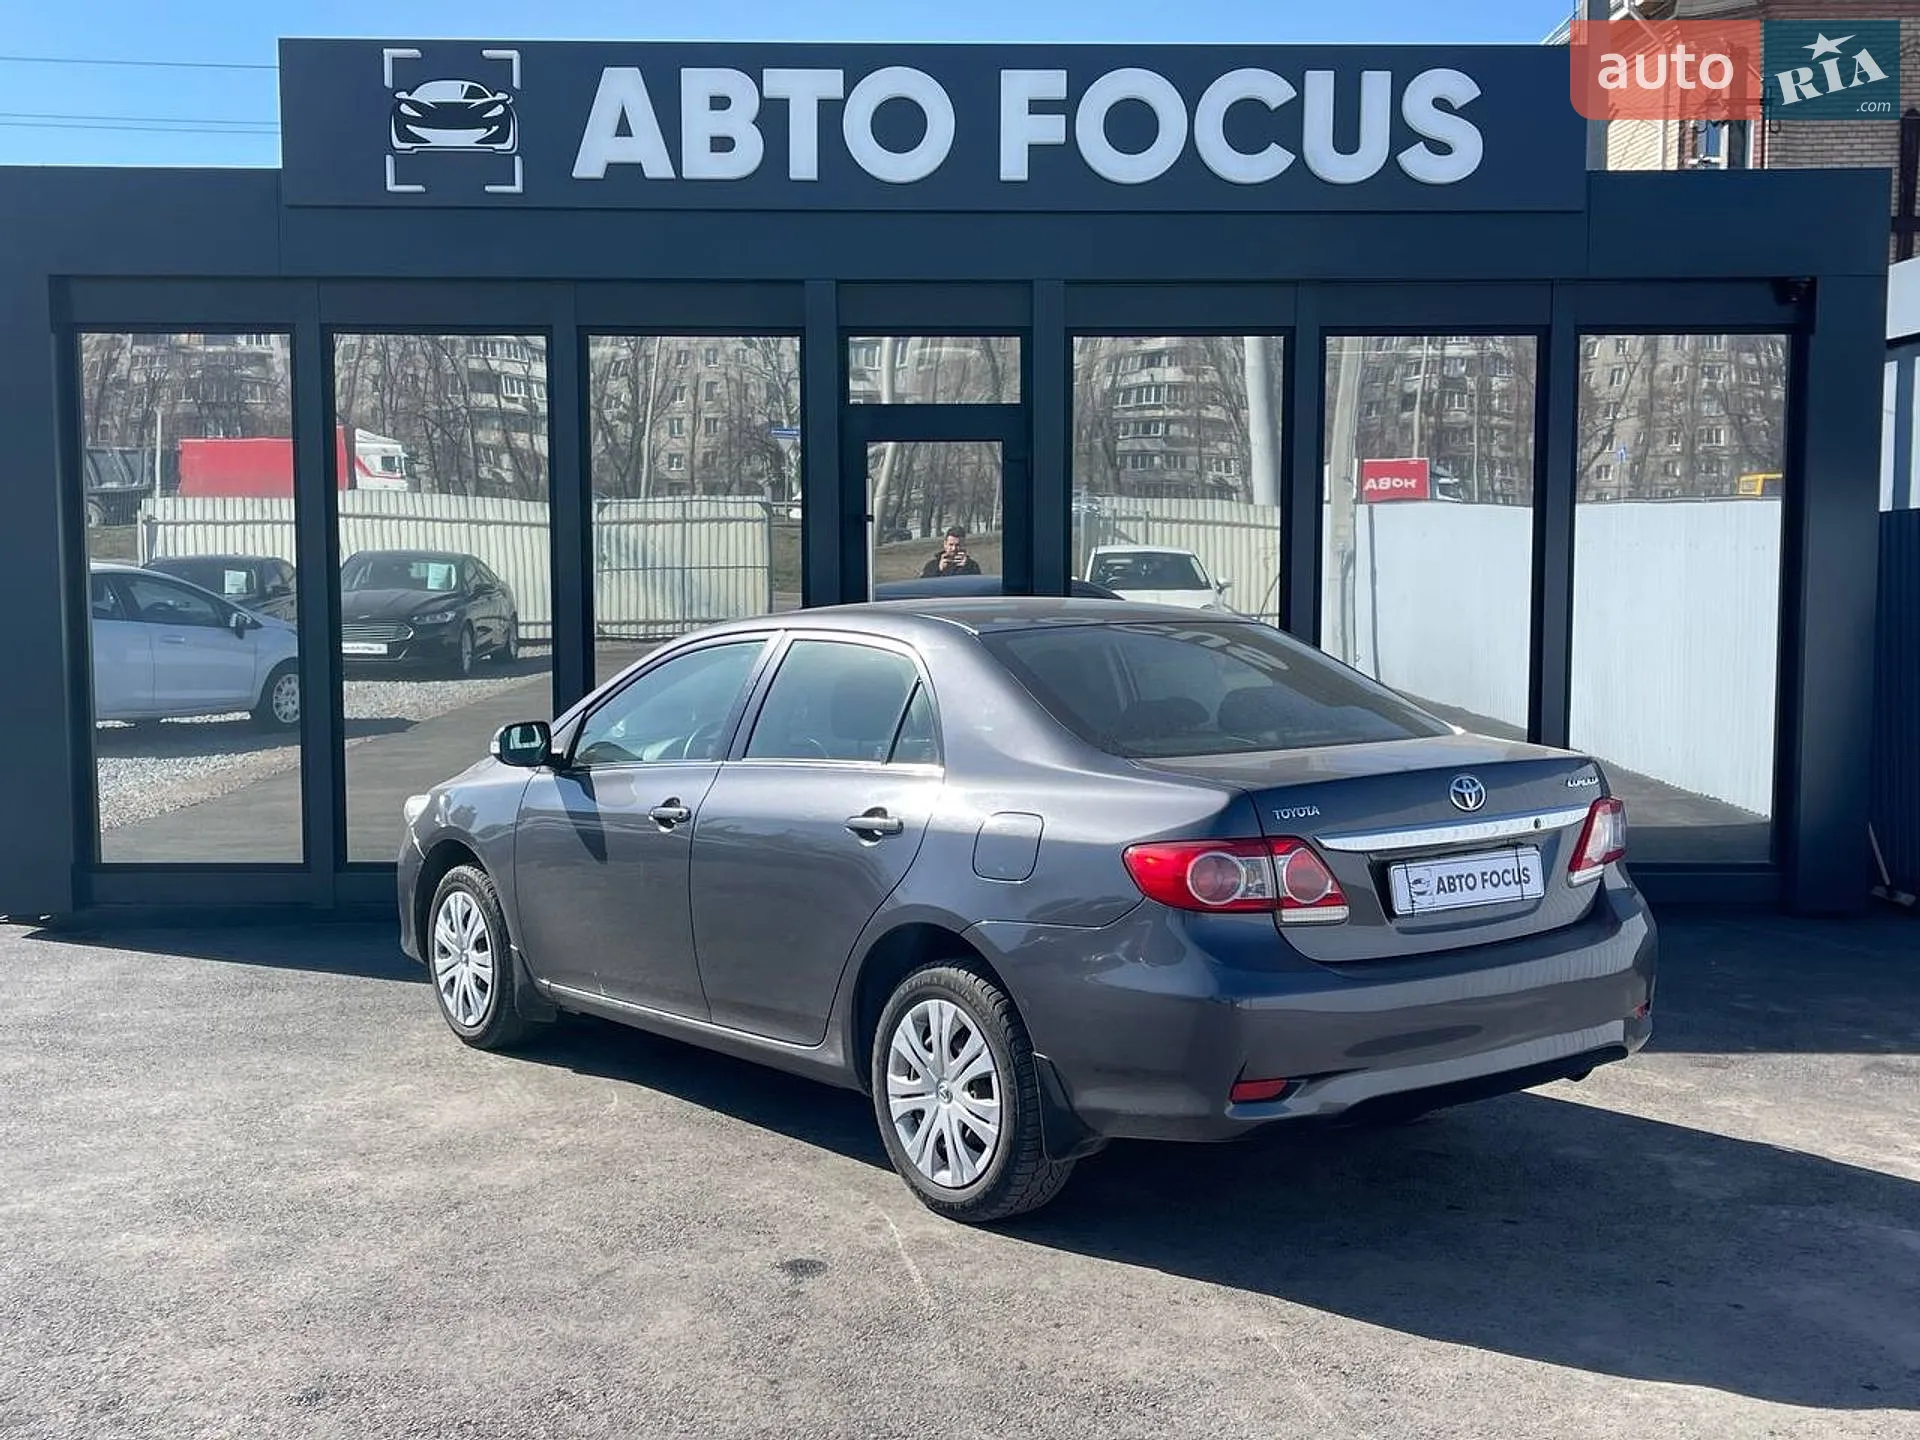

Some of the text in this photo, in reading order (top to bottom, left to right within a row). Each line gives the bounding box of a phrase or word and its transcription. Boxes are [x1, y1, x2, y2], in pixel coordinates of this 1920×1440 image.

[572, 65, 1484, 186] АВТО FOCUS
[1272, 805, 1321, 820] TOYOTA
[1436, 866, 1531, 896] АВТО FOCUS
